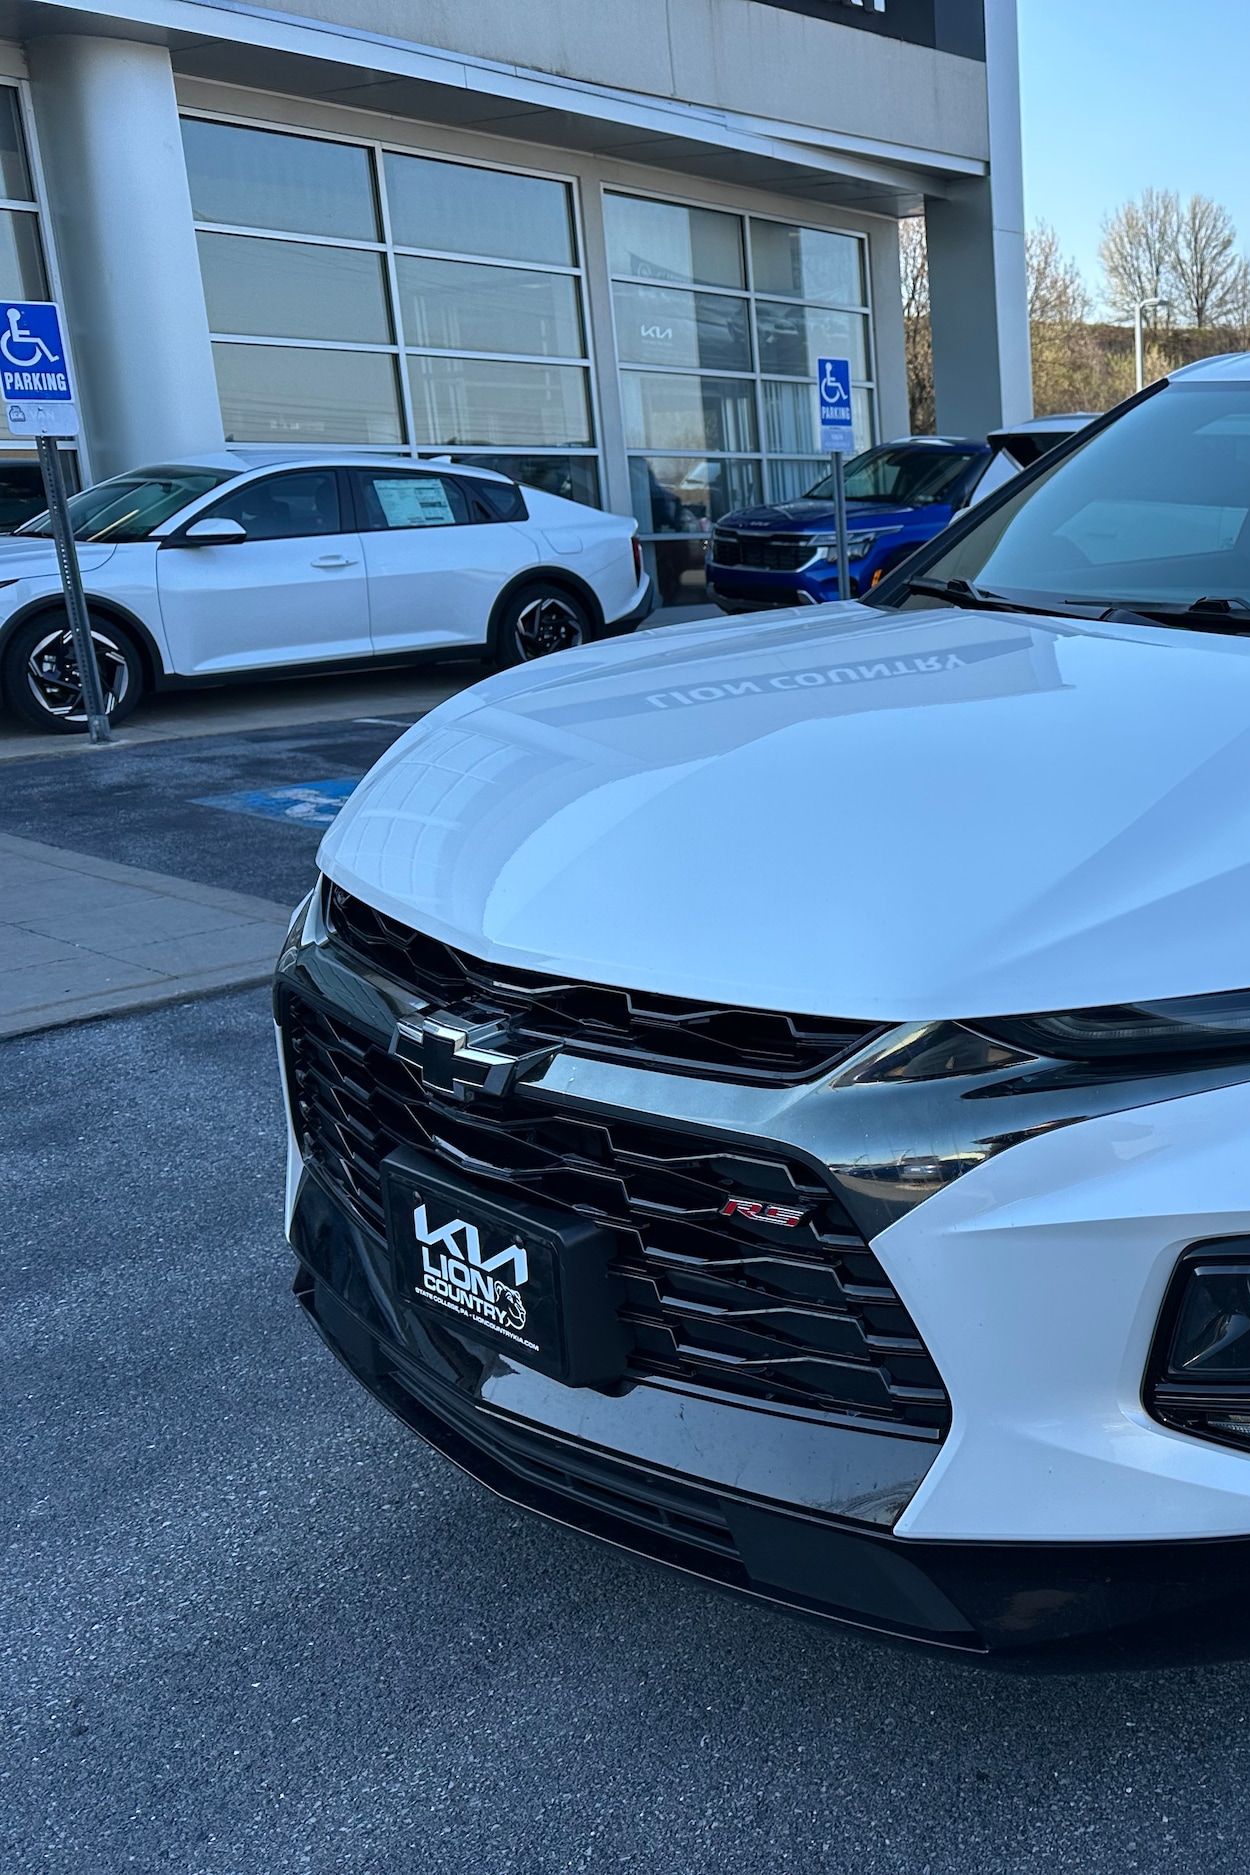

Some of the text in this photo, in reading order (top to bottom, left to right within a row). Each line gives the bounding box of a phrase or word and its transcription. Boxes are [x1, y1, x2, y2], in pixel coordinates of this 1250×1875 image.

[4, 372, 67, 391] PARKING
[29, 410, 55, 421] VAN
[822, 406, 850, 420] PARKING
[720, 1198, 805, 1228] RS
[414, 1204, 528, 1286] KIA
[421, 1245, 496, 1304] LION
[414, 1286, 435, 1301] STATE
[424, 1274, 507, 1324] COUNTRY
